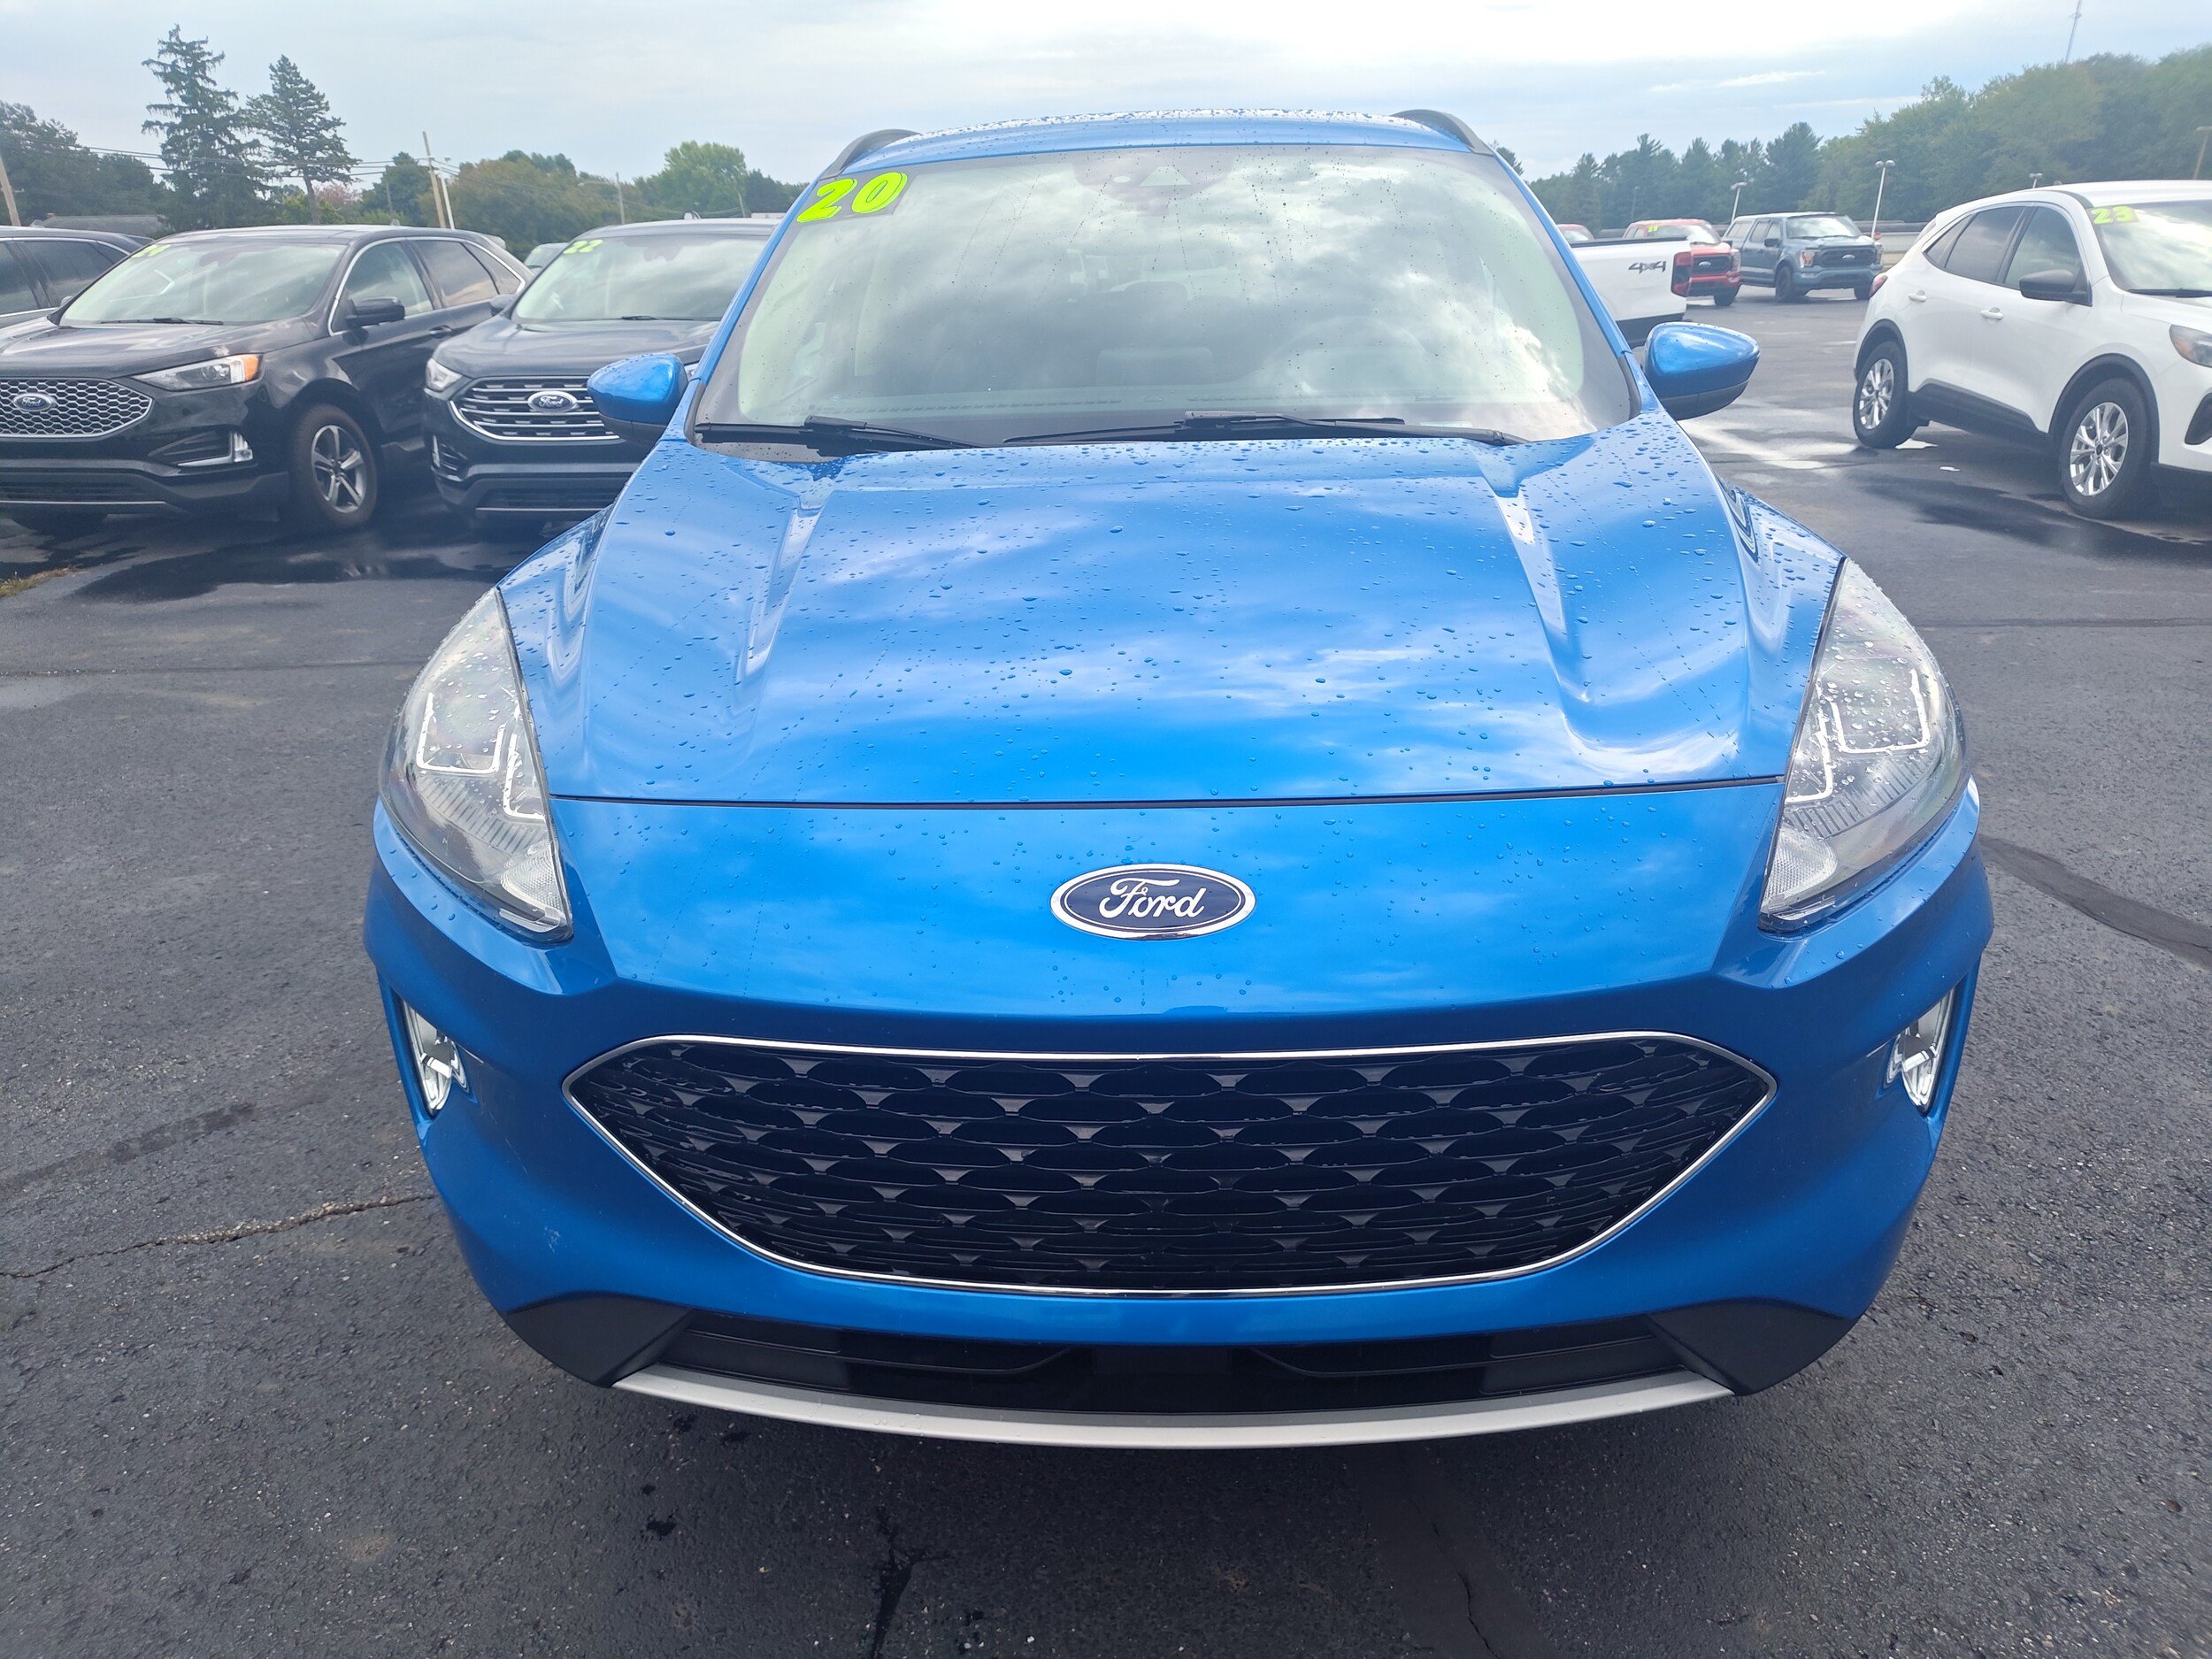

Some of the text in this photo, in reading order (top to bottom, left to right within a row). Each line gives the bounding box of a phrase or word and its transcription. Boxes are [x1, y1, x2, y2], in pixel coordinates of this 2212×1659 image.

[796, 172, 908, 223] 20
[2091, 205, 2133, 224] 23
[563, 239, 603, 255] 22
[21, 396, 42, 406] Ford
[538, 396, 565, 407] Ford
[1098, 877, 1207, 918] Ford
